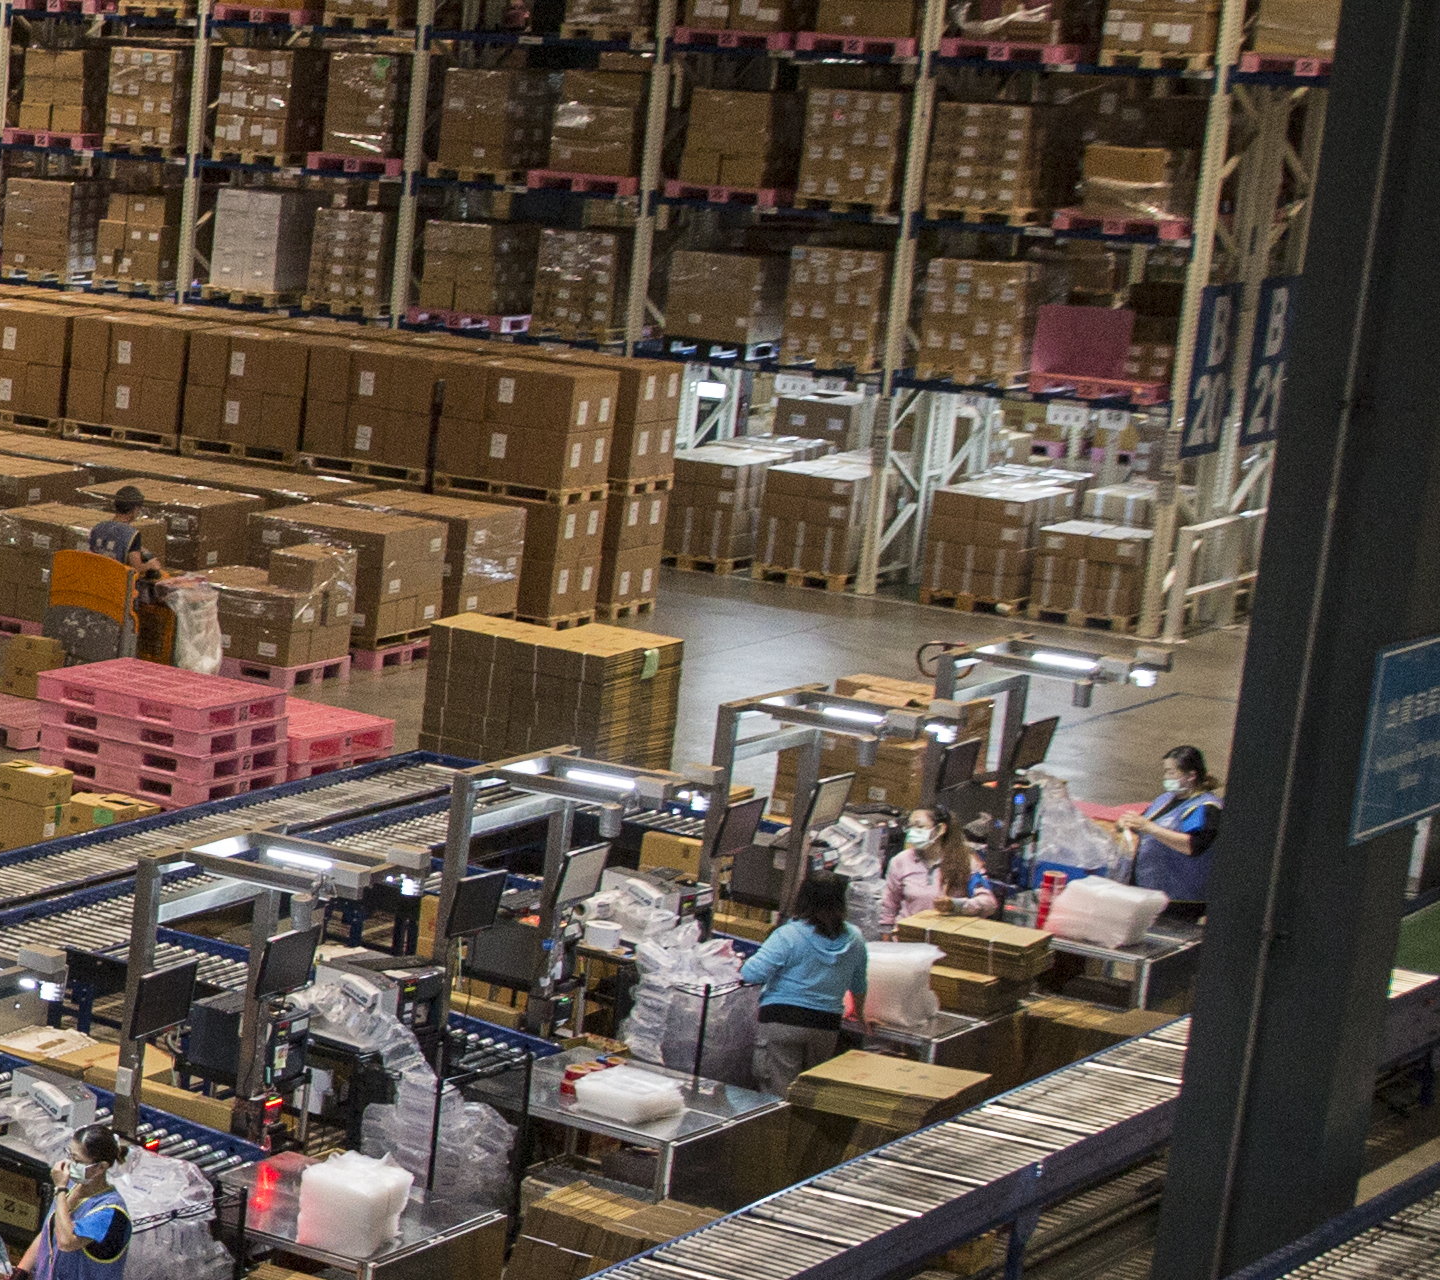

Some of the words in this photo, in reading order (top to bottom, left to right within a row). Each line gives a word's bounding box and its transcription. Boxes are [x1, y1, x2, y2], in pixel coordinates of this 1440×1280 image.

[1208, 295, 1230, 367] B
[1264, 286, 1288, 357] B
[1188, 373, 1225, 445] 20
[1249, 362, 1287, 436] 21
